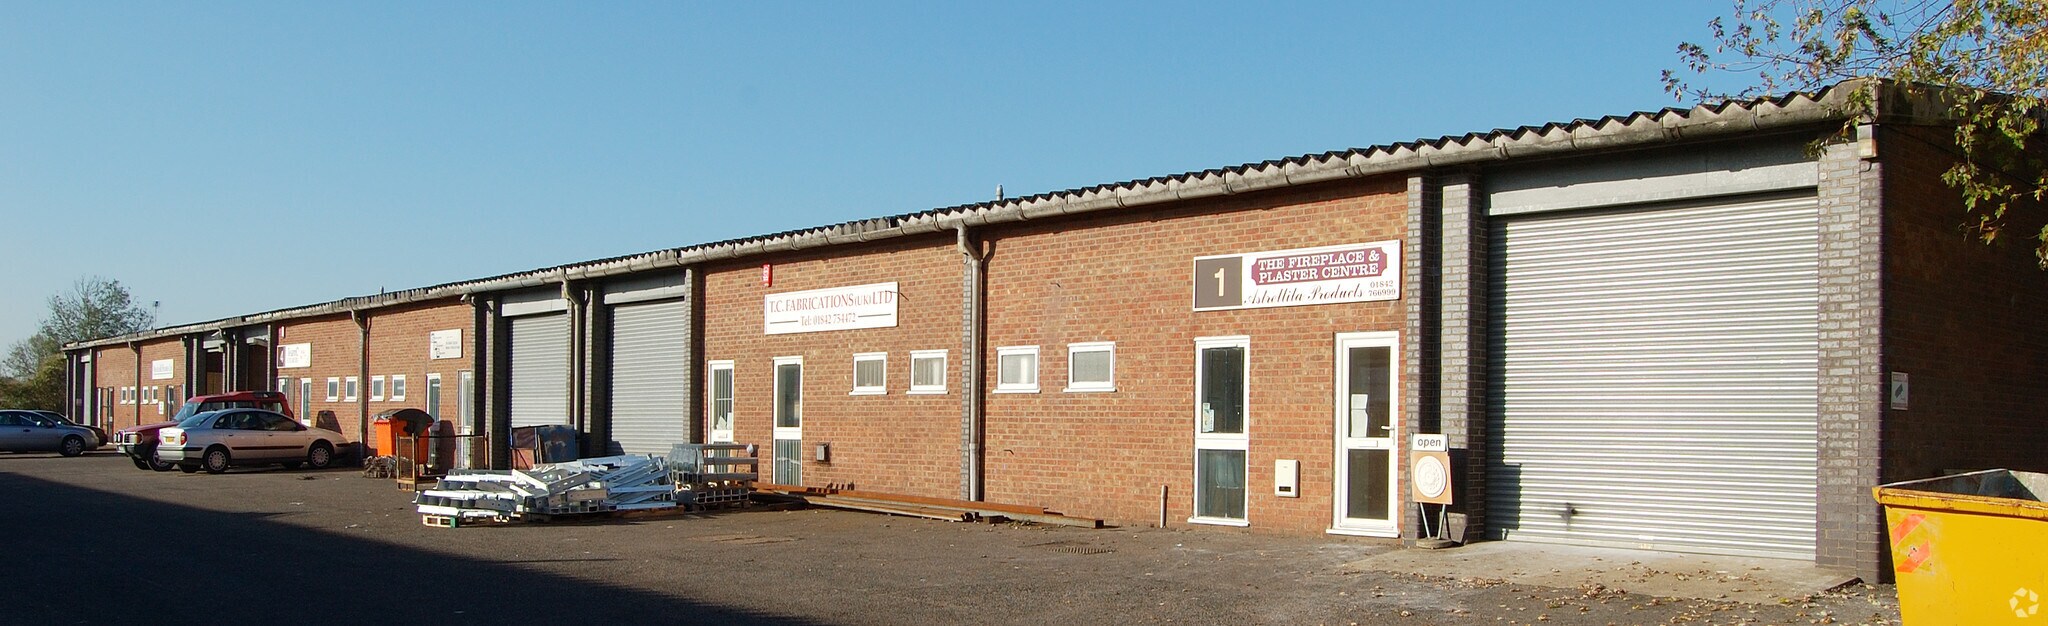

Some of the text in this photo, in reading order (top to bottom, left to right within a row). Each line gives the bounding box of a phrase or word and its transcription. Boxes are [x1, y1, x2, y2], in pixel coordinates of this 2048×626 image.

[1258, 249, 1380, 271] THE FIREPLACE &
[1258, 262, 1379, 283] PLASTER CENTRE
[1214, 267, 1225, 297] 1
[1369, 279, 1394, 289] 01842
[1307, 283, 1363, 301] Products
[769, 299, 785, 314] T.C.
[801, 312, 856, 328] Tel: 01842 754472
[1417, 438, 1442, 448] open
